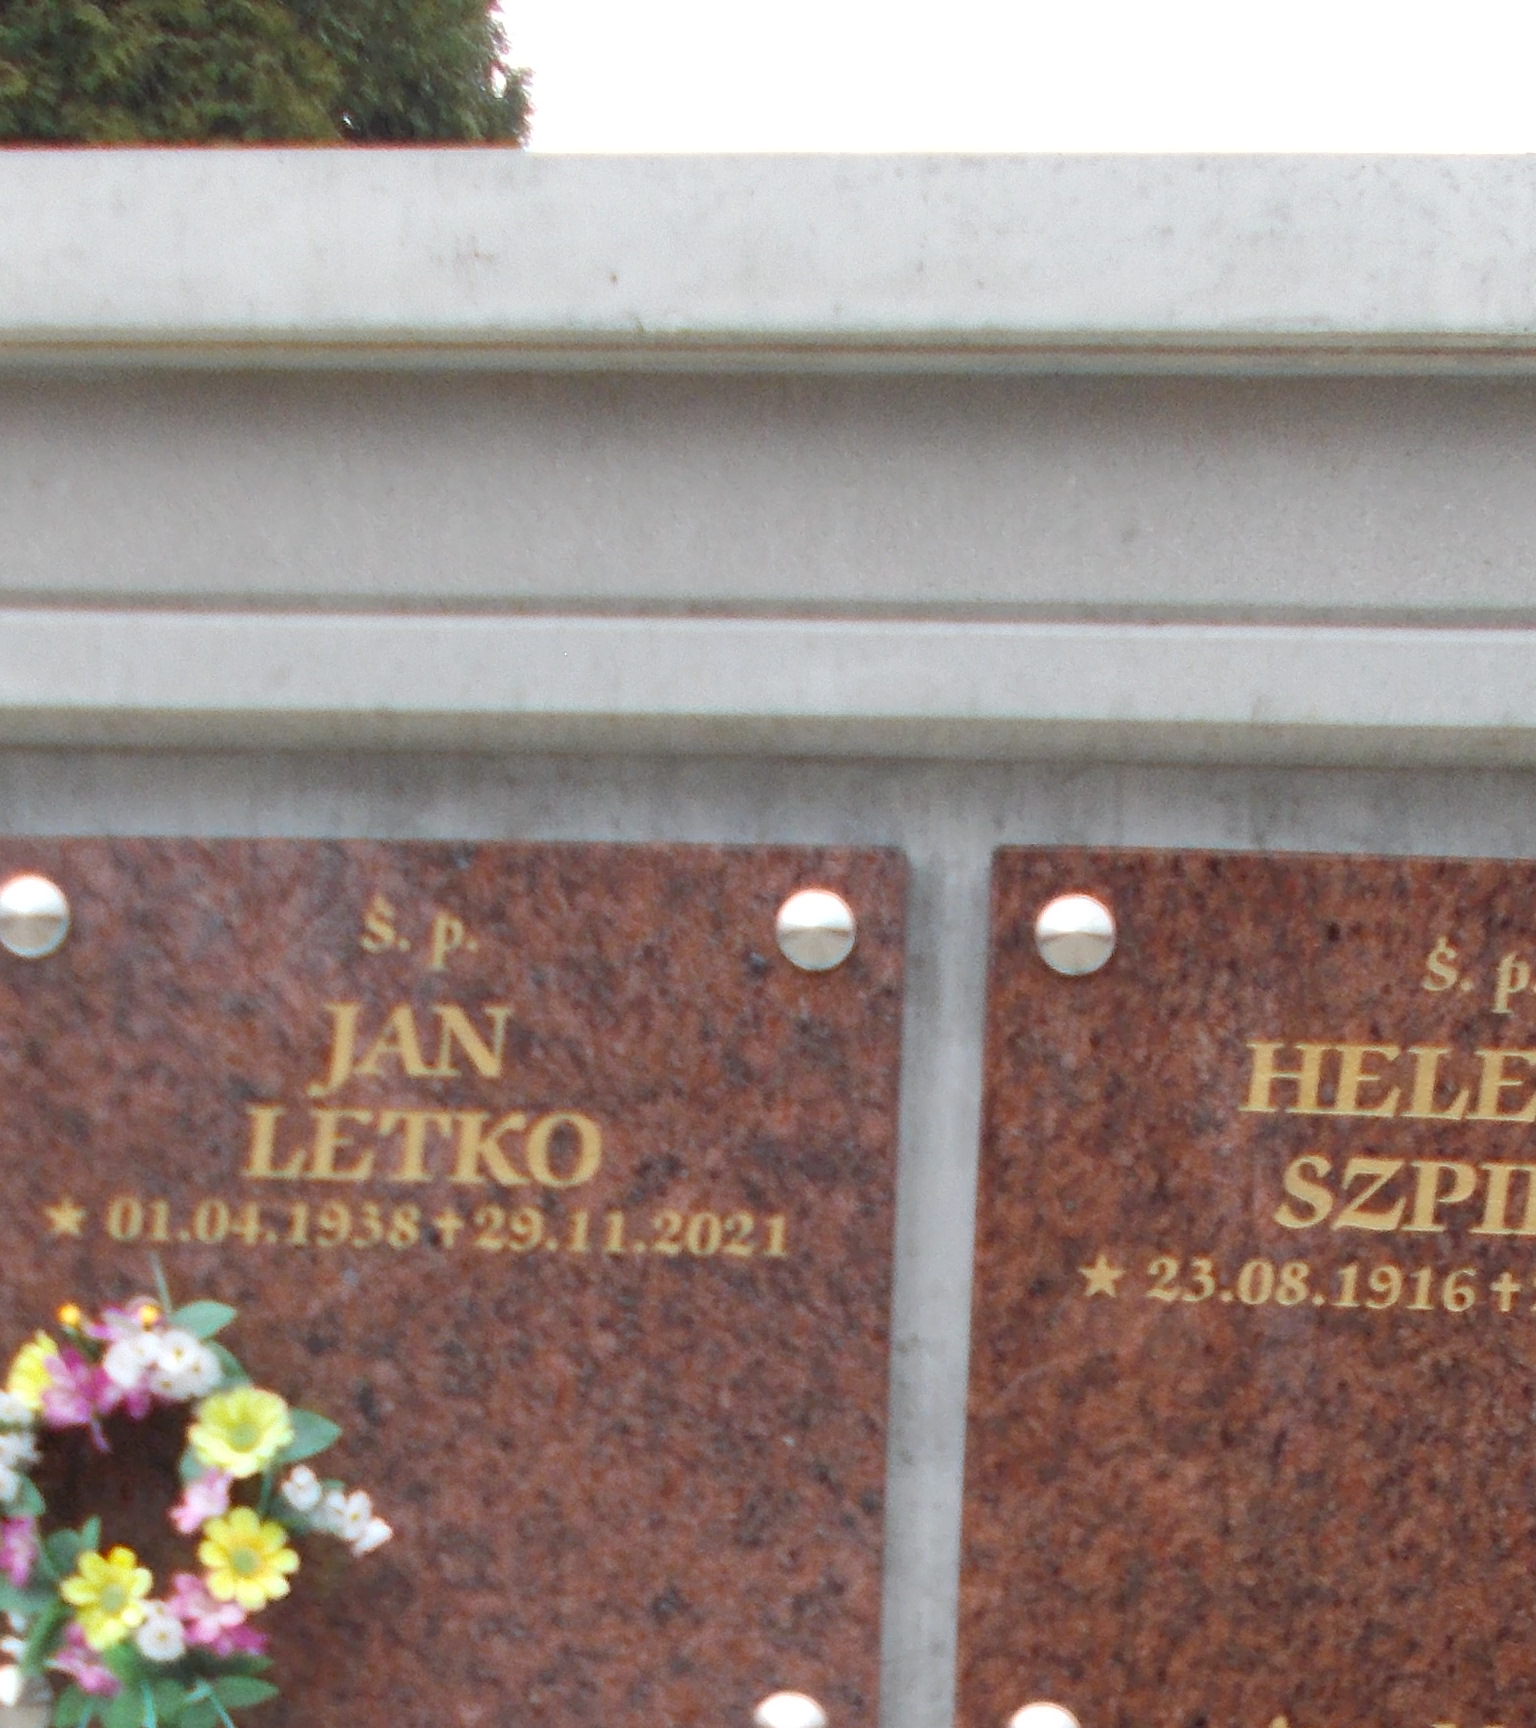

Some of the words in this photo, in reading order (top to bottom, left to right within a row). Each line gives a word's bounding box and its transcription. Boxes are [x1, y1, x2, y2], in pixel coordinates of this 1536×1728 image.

[307, 1002, 514, 1097] JAN
[239, 1104, 605, 1189] LETKO
[1146, 1255, 1477, 1312] 23.08.1916
